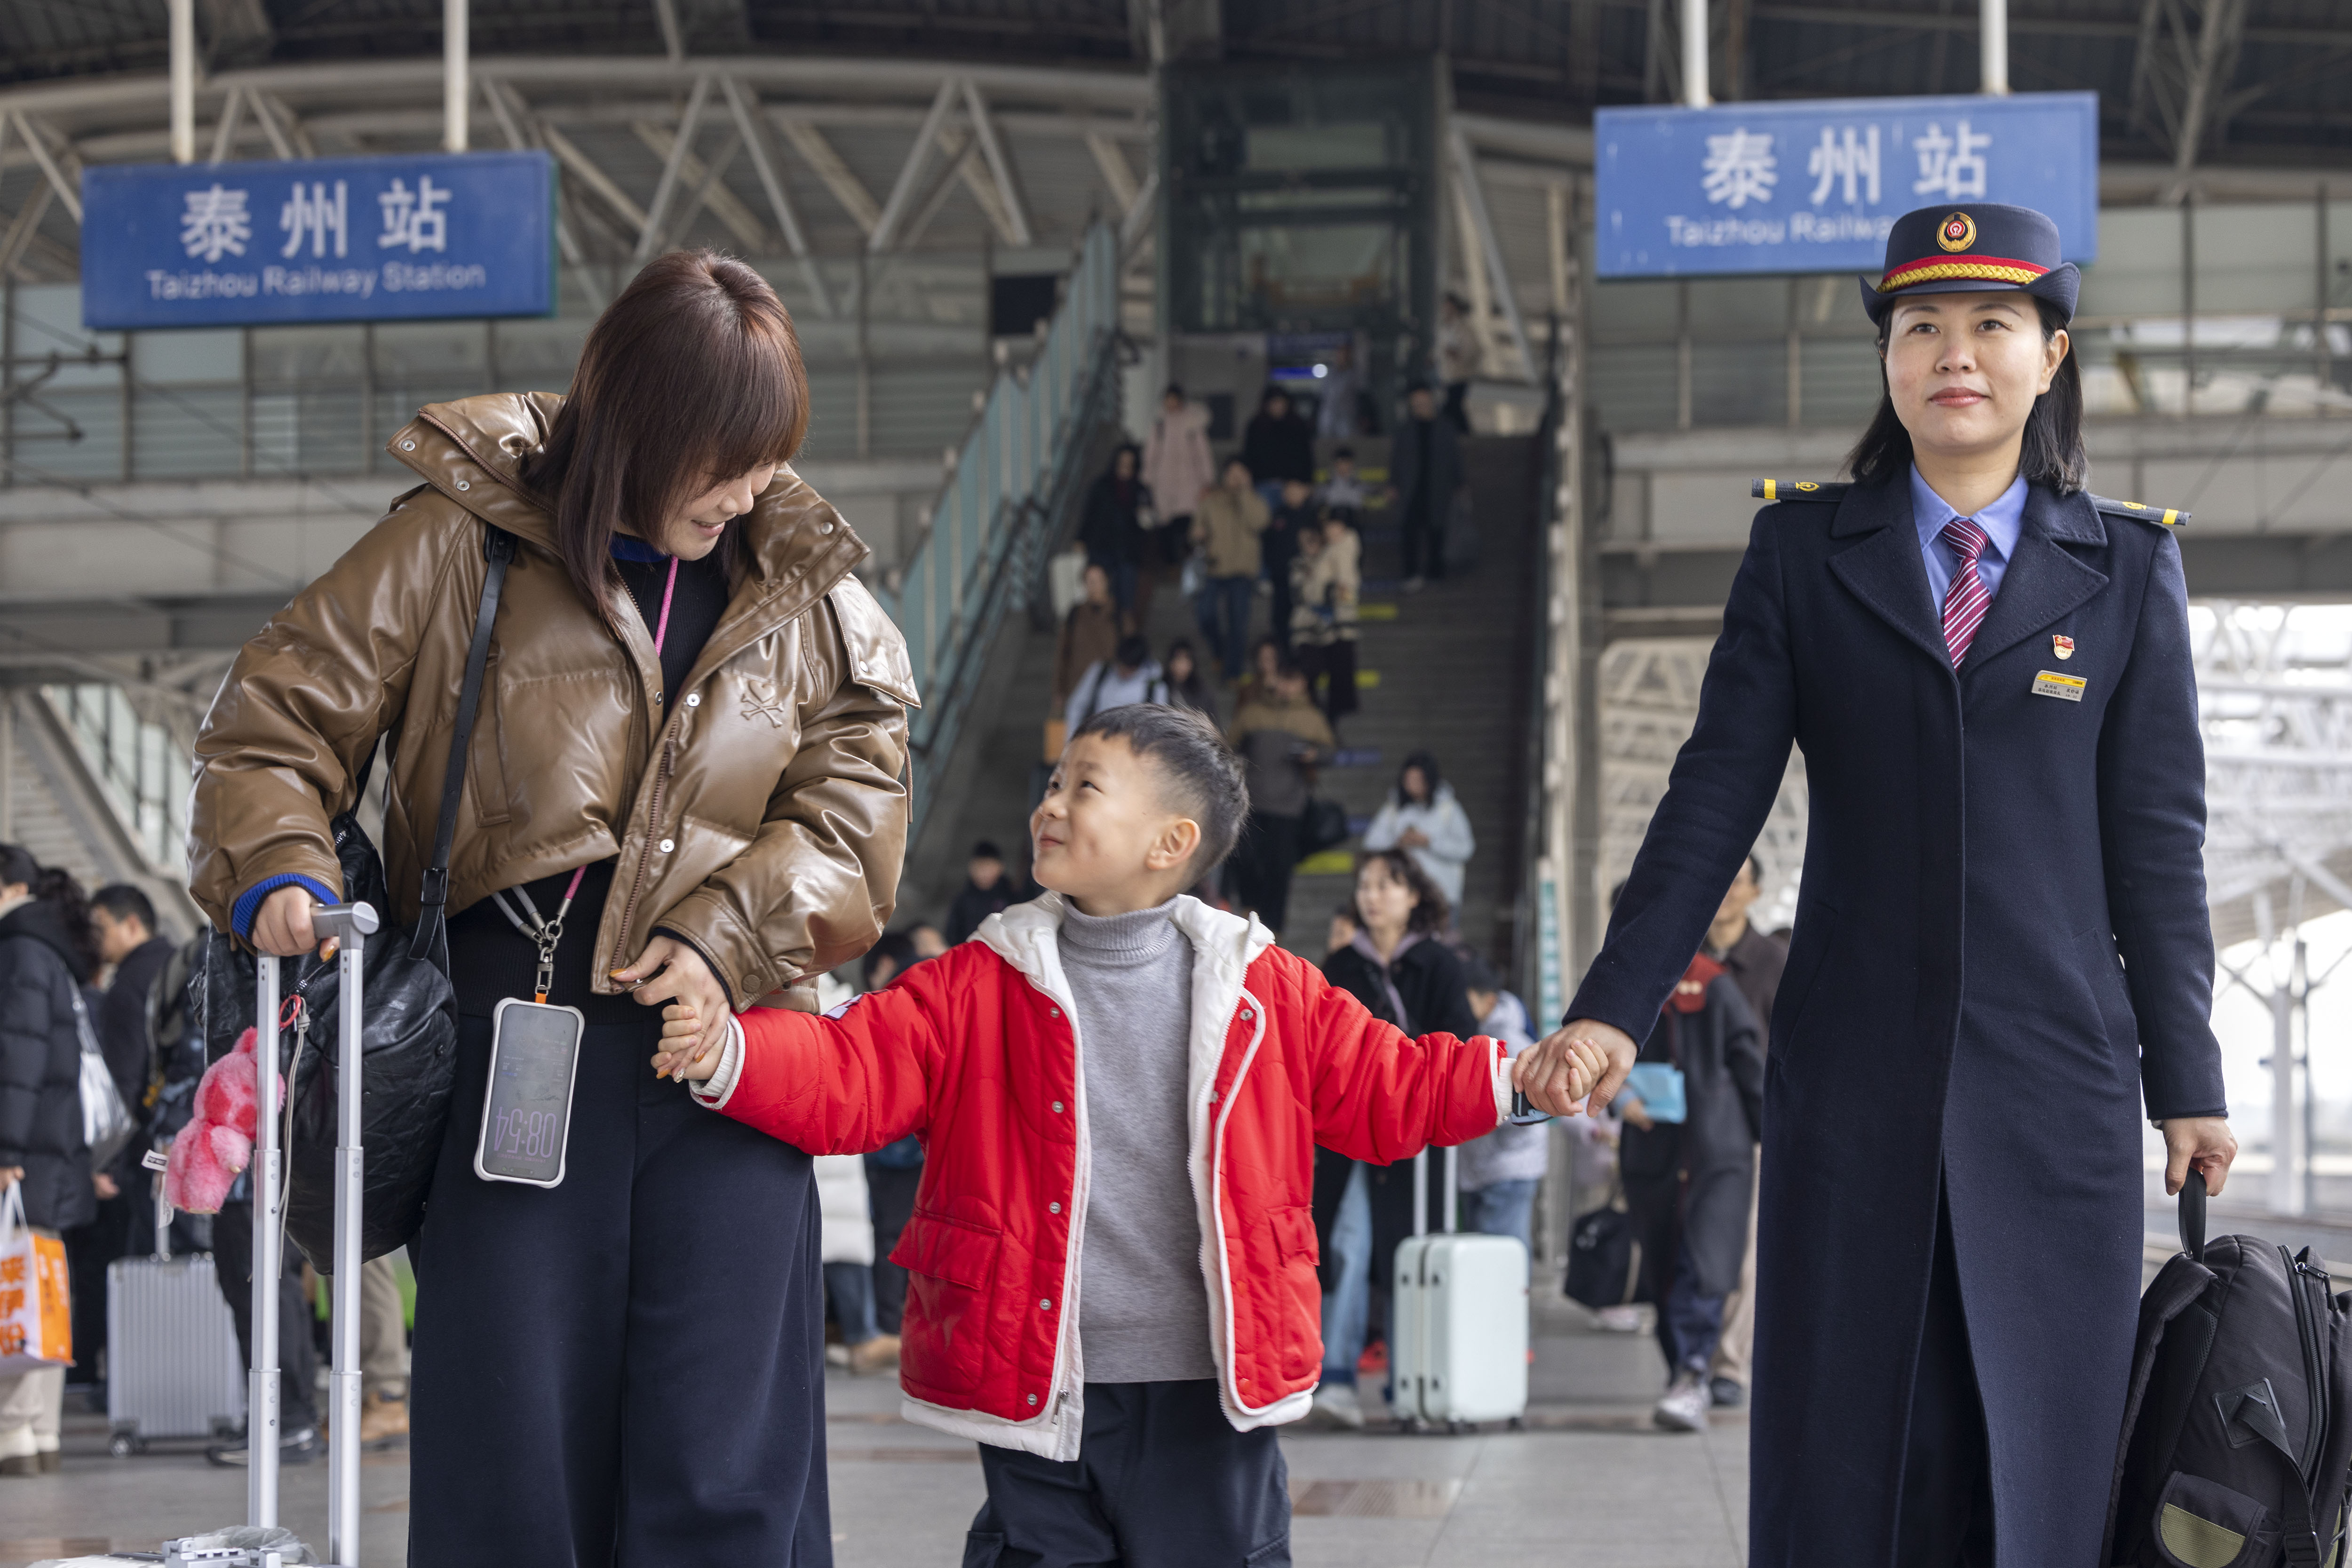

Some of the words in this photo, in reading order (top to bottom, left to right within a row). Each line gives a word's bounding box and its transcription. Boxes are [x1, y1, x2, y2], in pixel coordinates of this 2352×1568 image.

[1702, 120, 1991, 208] 泰州站
[181, 176, 451, 262] 泰州站
[1666, 215, 1785, 246] Taizhou
[1790, 211, 1893, 244] Railwa
[146, 270, 258, 300] Taizhou
[263, 266, 376, 300] Railway
[382, 261, 485, 292] Station
[494, 1107, 556, 1158] 08:54
